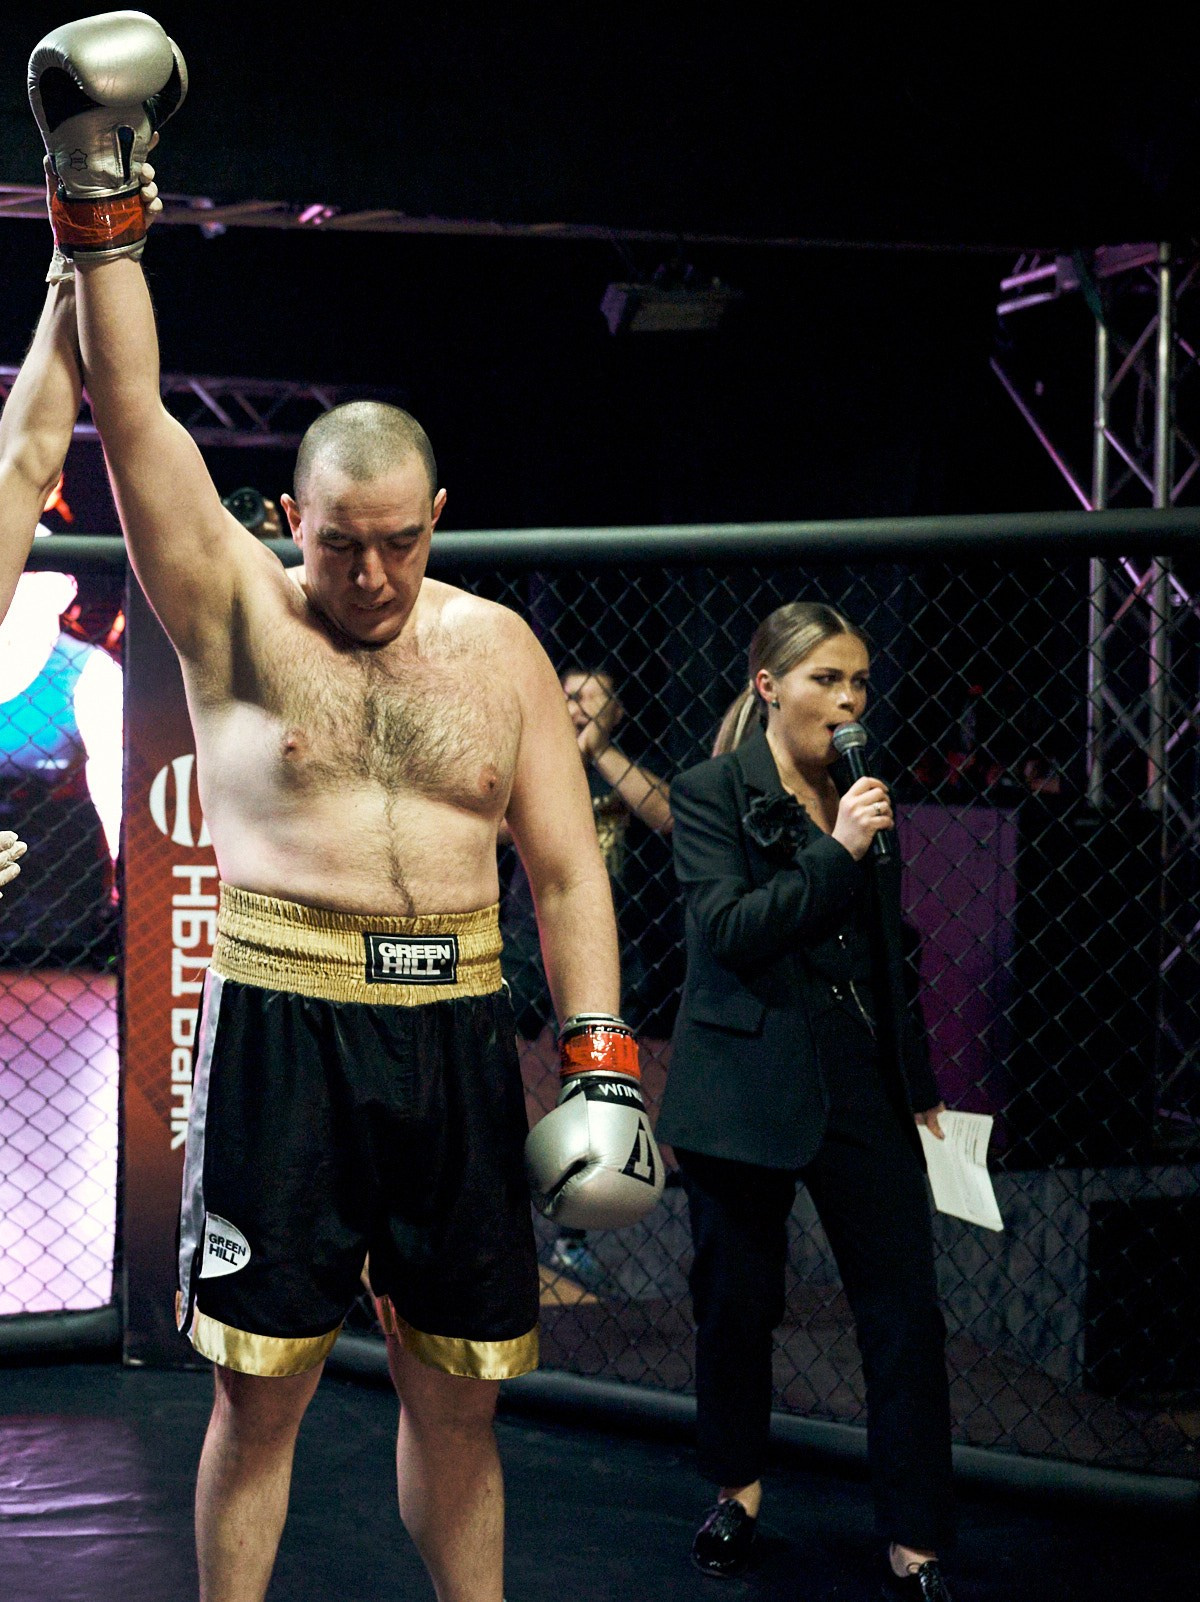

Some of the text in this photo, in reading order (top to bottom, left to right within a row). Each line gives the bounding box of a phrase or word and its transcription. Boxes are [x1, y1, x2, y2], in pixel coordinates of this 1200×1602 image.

[378, 942, 450, 960] GREEN
[381, 956, 441, 976] HILL
[208, 1233, 246, 1257] GREEN
[208, 1243, 238, 1267] HILL
